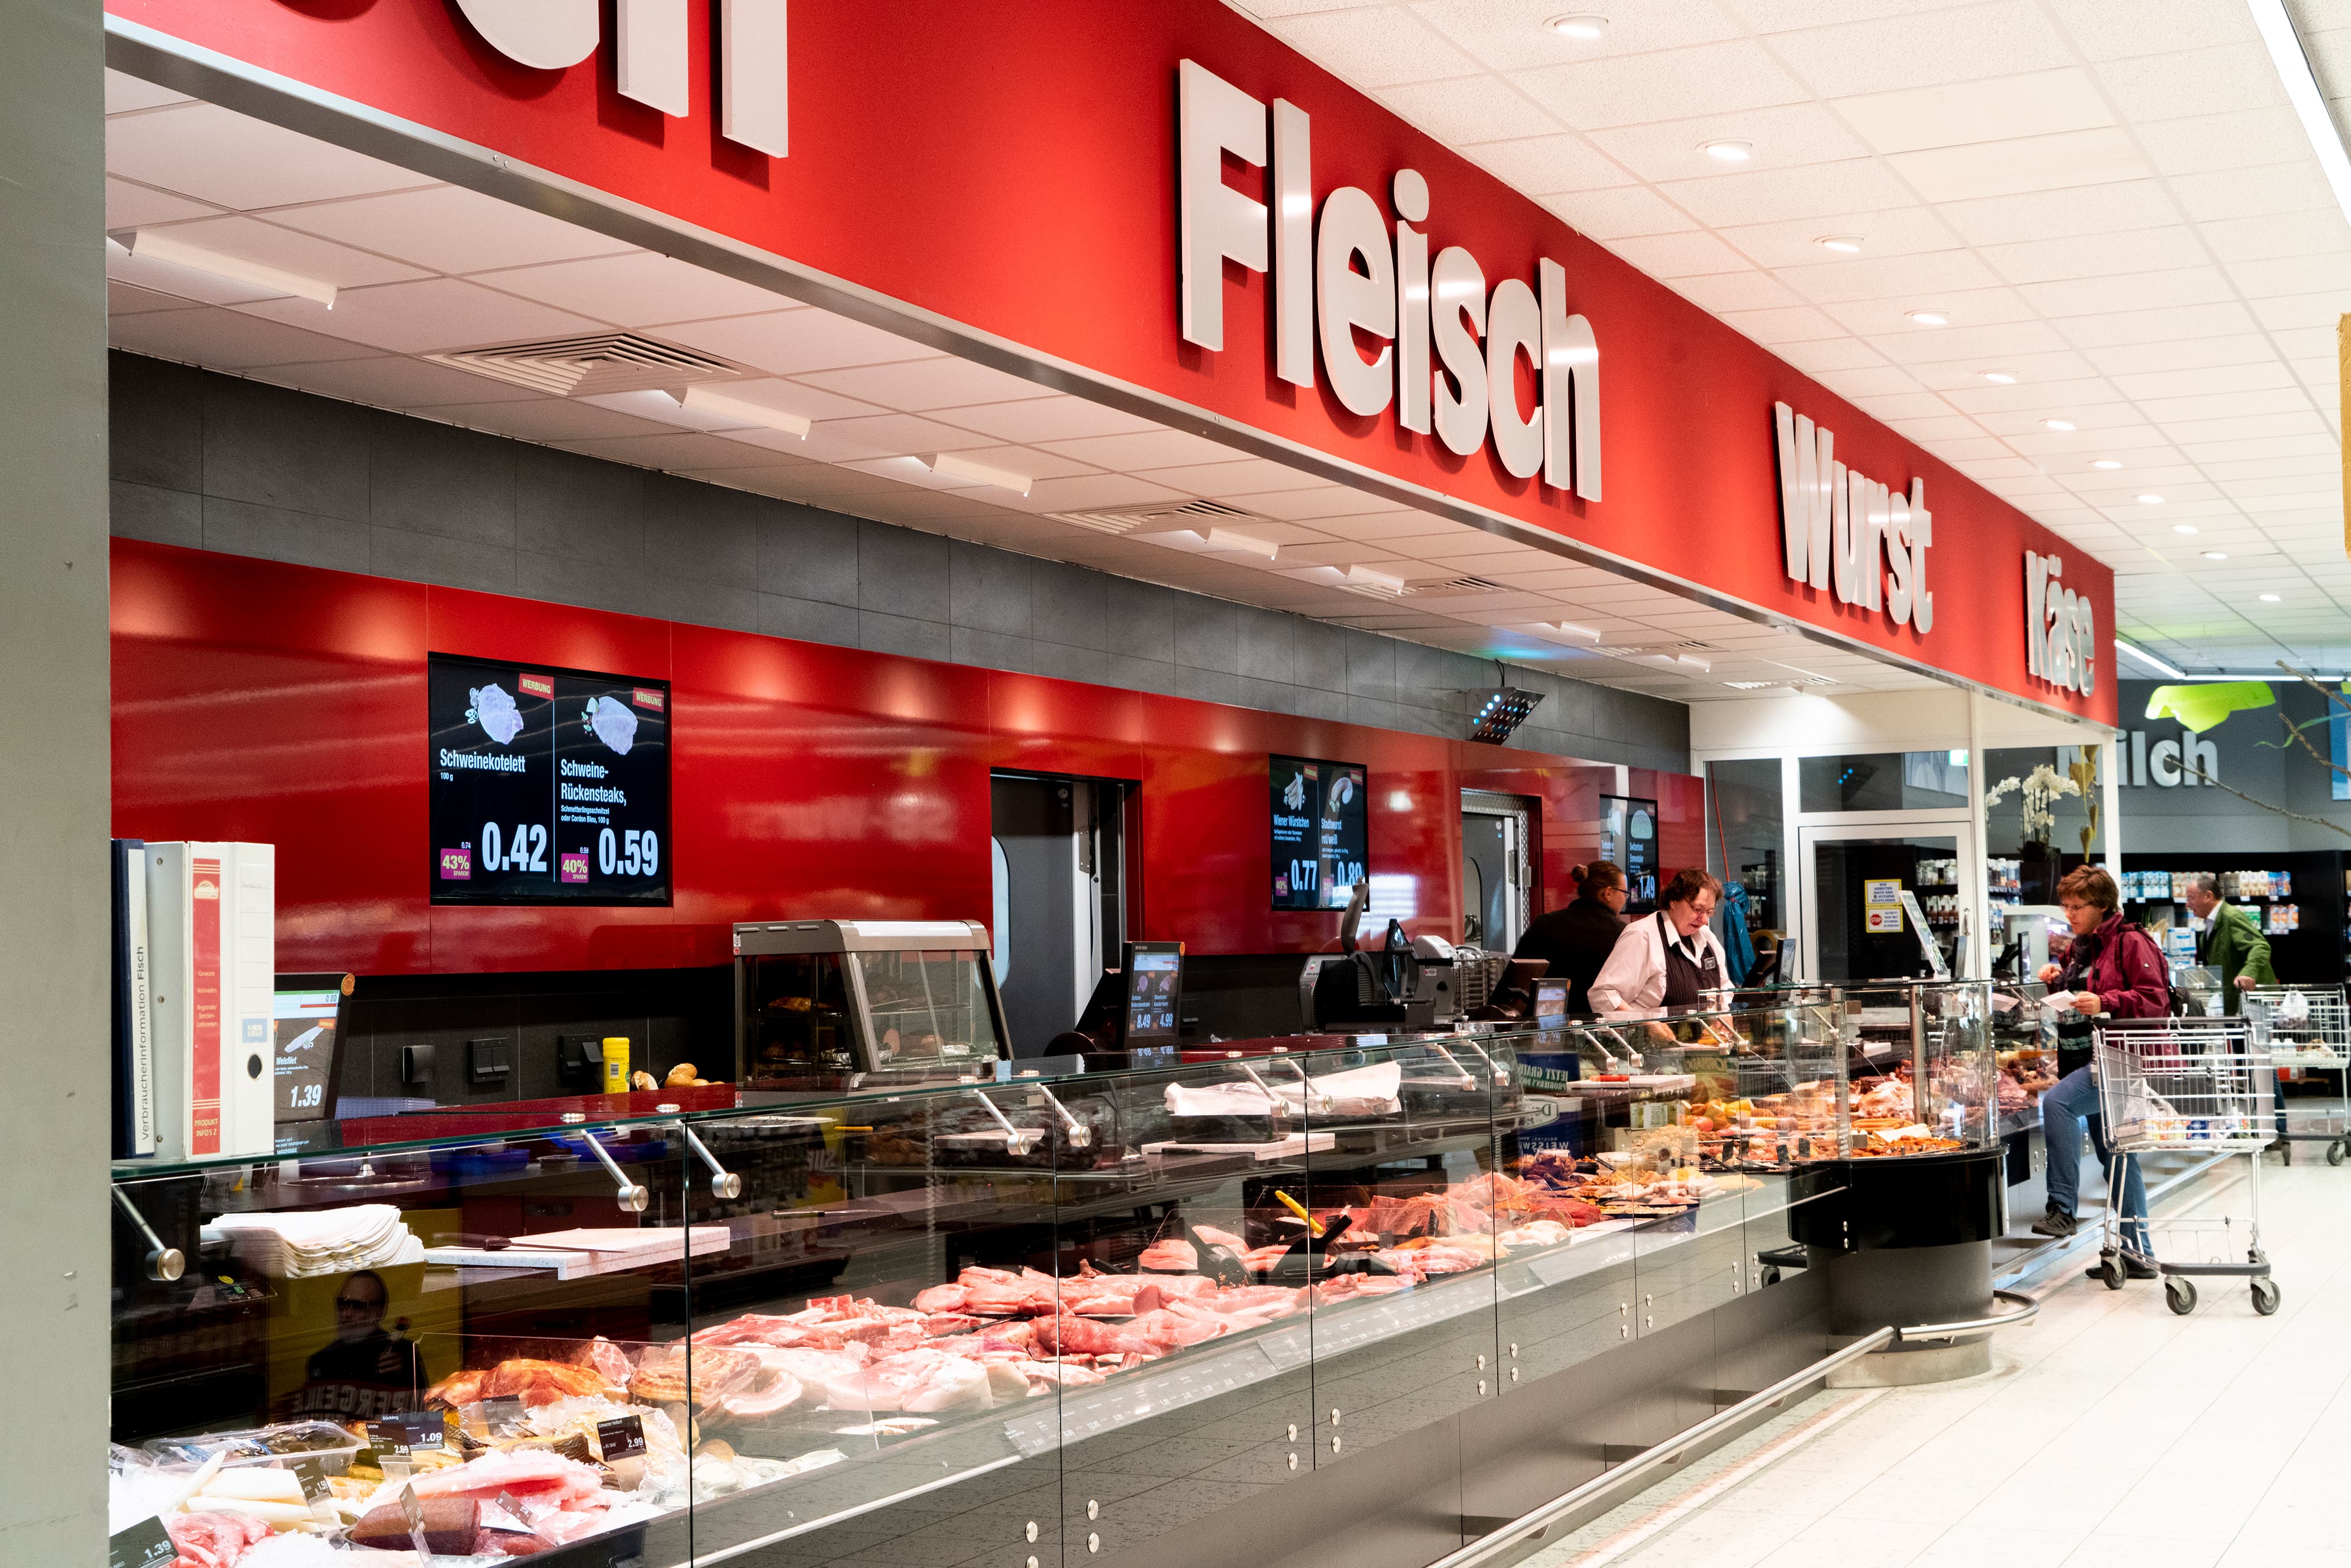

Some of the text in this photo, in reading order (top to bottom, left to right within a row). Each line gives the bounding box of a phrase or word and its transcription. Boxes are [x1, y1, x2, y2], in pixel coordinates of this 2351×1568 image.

[1180, 58, 1602, 503] Fleisch
[1776, 401, 1933, 634] Wurst
[2026, 550, 2095, 697] Käse
[522, 678, 552, 694] WERBUNG
[636, 692, 662, 707] WERBUNG
[440, 748, 526, 773] Schweinekotelett
[561, 759, 609, 779] Schweine-
[441, 772, 449, 780] 100
[561, 782, 627, 806] Rückensteaks,
[1273, 814, 1310, 828] Wiener Würstchen
[1321, 818, 1342, 830] Stadtwurst
[482, 821, 547, 872] 0.42
[598, 828, 659, 876] 0.59
[442, 855, 469, 869] 43%
[562, 859, 588, 874] 40%
[1291, 859, 1317, 890] 0.77
[1276, 880, 1287, 890] 40%
[1640, 876, 1655, 899] 1.49
[1136, 1013, 1151, 1029] 8.49
[1159, 1013, 1173, 1028] 4.99
[138, 984, 149, 1141] Verbraucherinformation
[290, 1084, 322, 1107] 1.39
[420, 1432, 443, 1442] 1.09
[627, 1437, 644, 1448] 2.99
[394, 1444, 409, 1454] 2.69
[144, 1540, 171, 1559] 1.39
